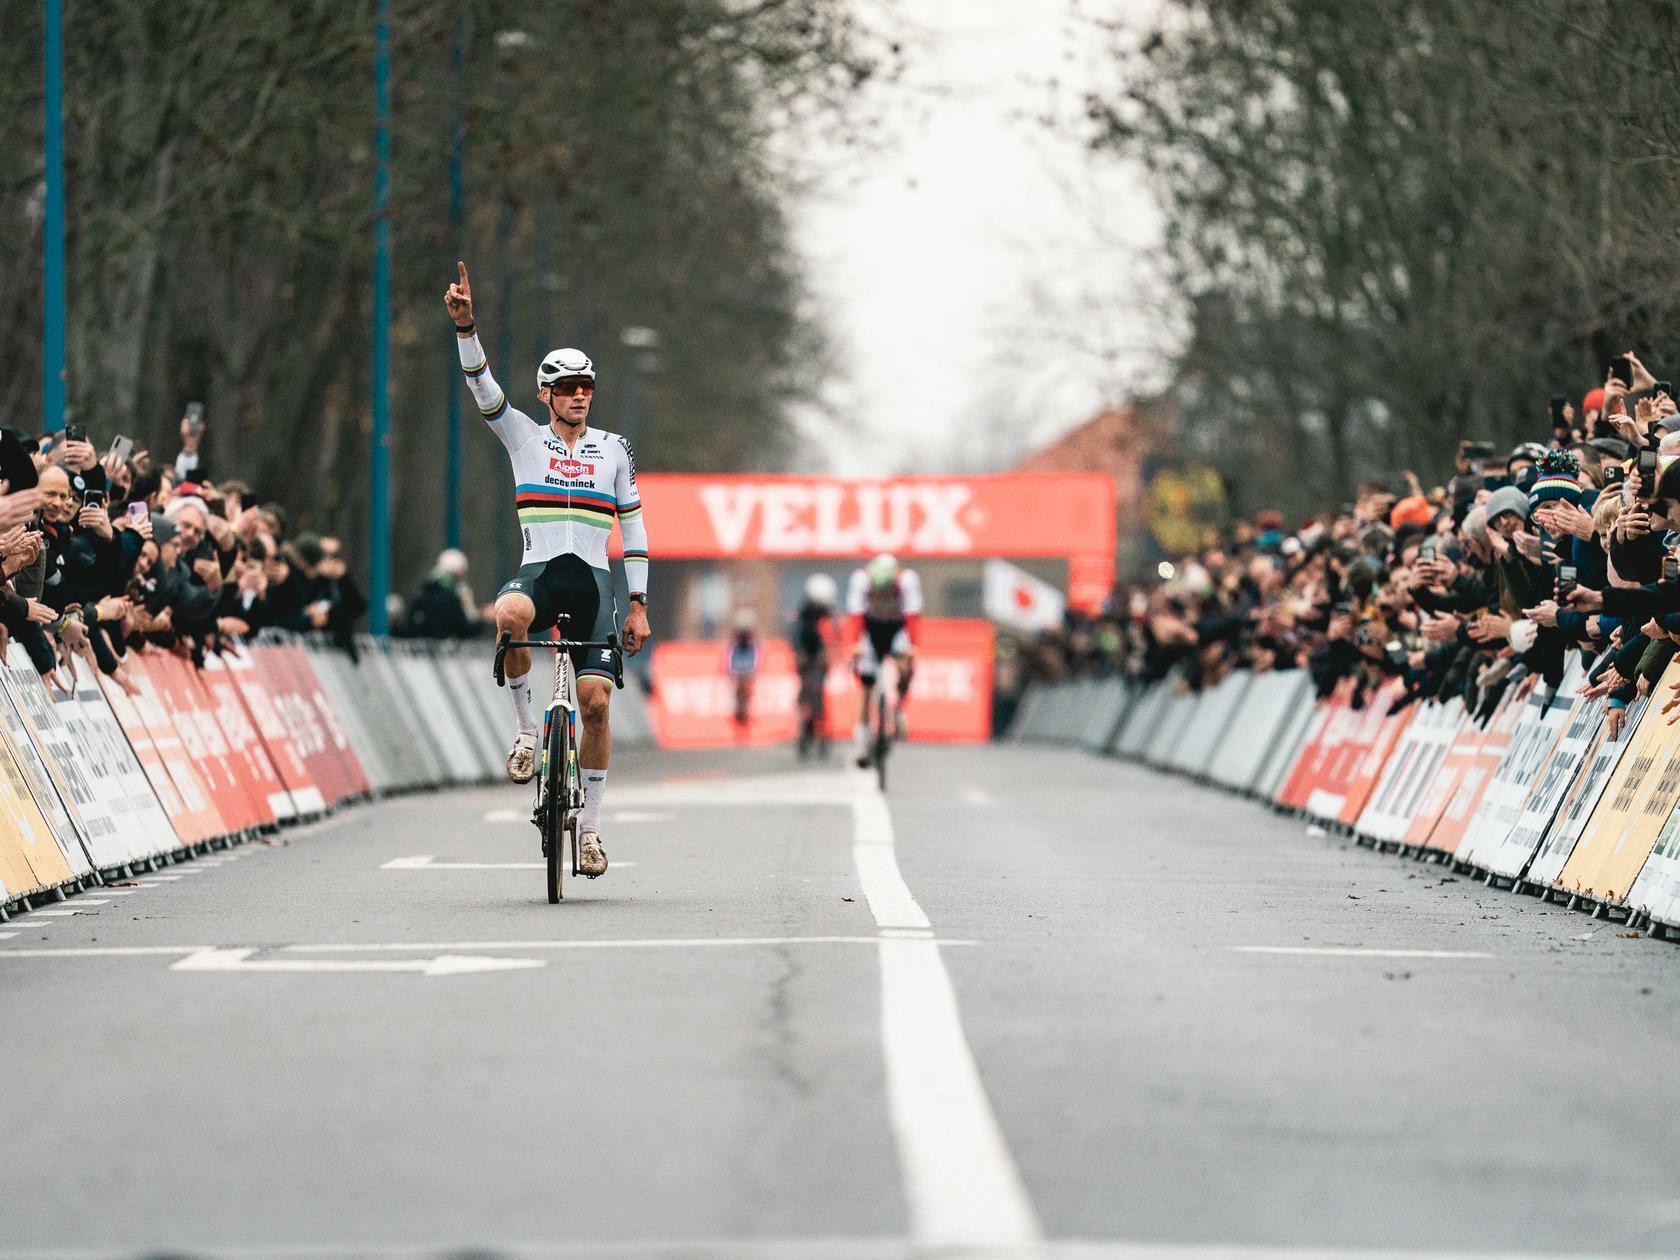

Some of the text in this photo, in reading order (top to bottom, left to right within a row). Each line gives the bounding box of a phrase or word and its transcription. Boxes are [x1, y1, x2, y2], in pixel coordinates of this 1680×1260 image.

[548, 441, 567, 456] UCI
[553, 461, 589, 474] Alpecin
[544, 474, 595, 489] deceuninck
[701, 483, 972, 551] VELUX
